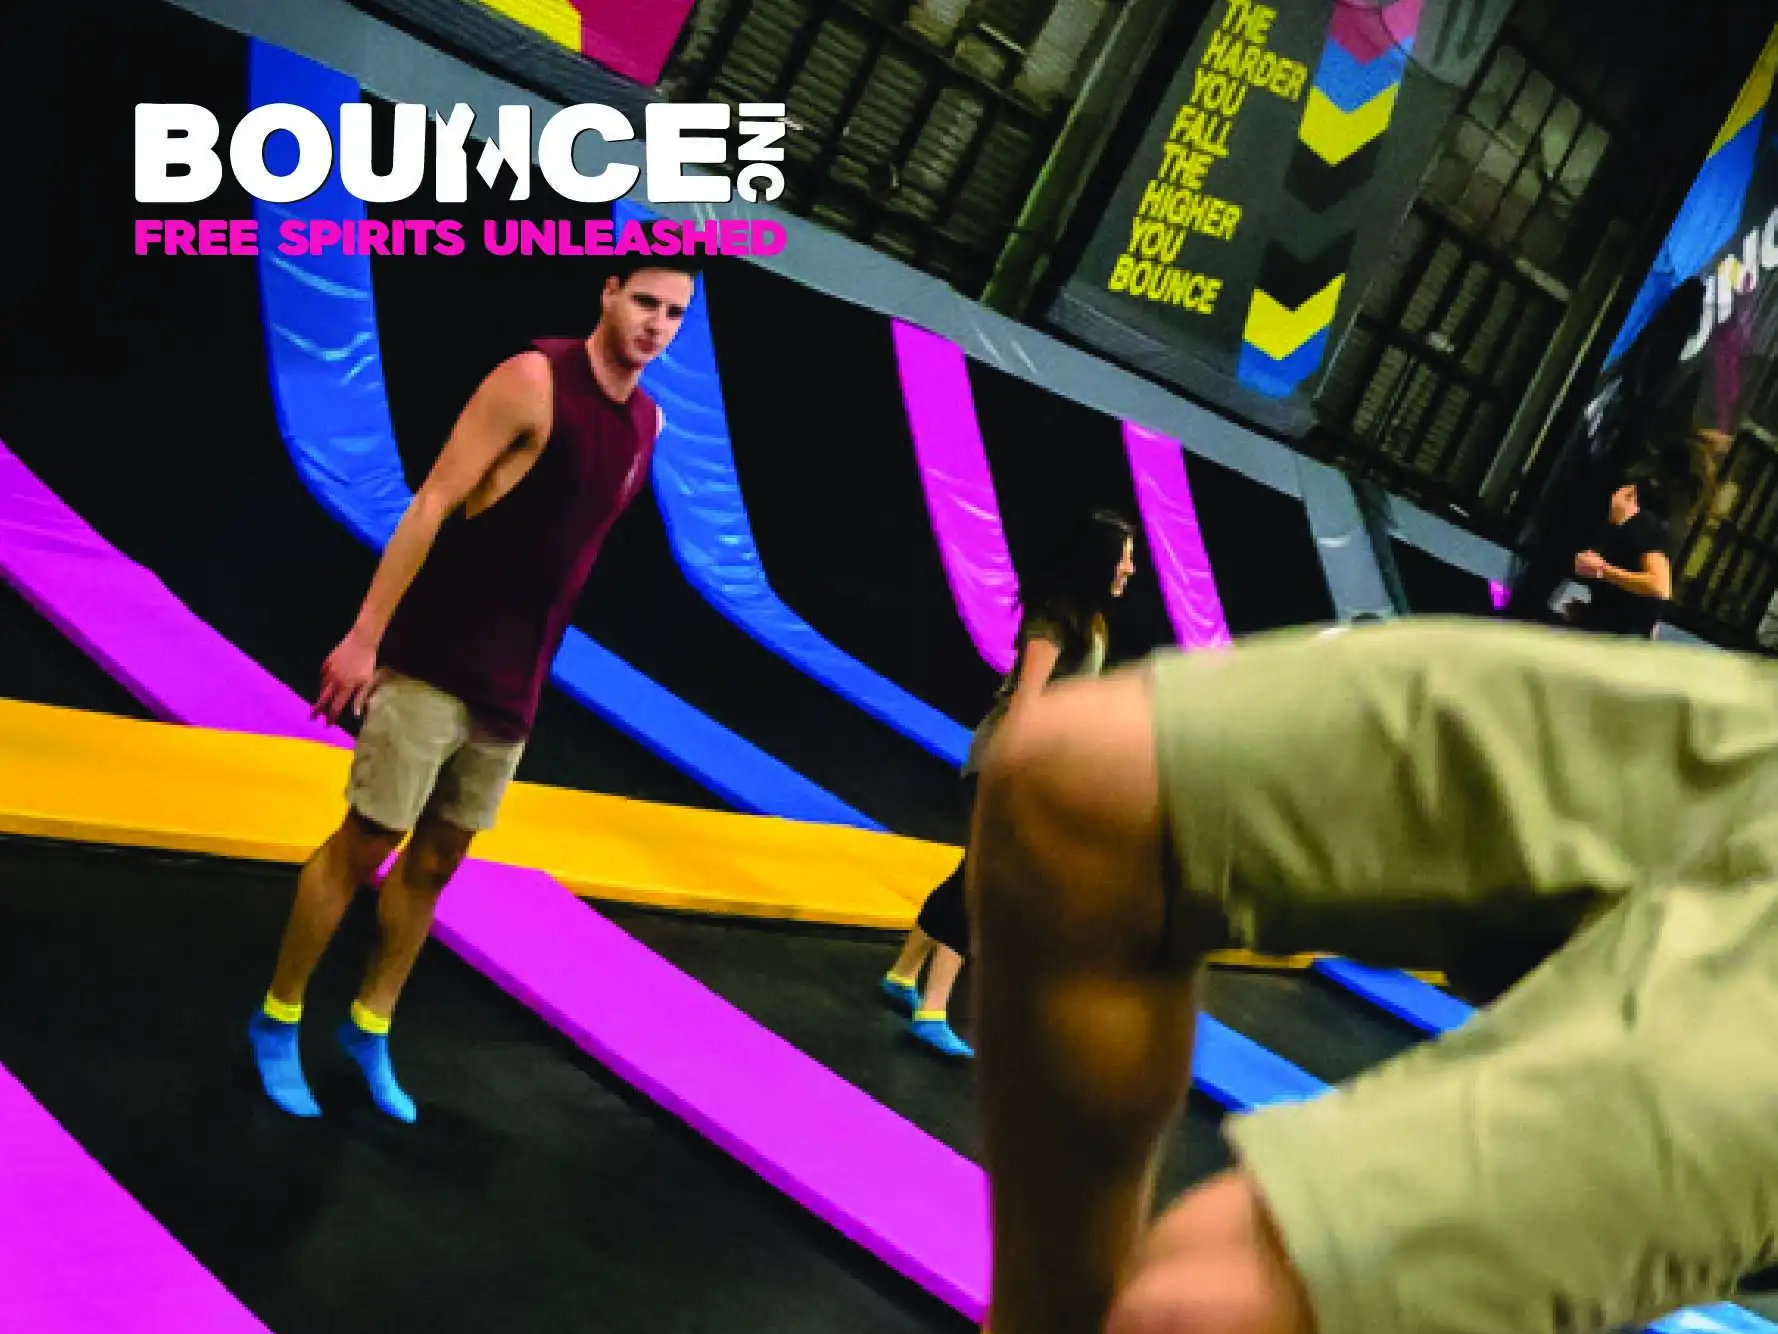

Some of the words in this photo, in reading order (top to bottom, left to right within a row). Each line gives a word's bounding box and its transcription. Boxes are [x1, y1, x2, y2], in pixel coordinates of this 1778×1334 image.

[1191, 66, 1249, 118] YOU
[1201, 29, 1308, 103] HARDER
[1167, 104, 1232, 158] FALL
[1157, 141, 1214, 190] THE
[1138, 179, 1244, 242] HIGHER
[1127, 216, 1188, 262] YOU
[1108, 253, 1224, 315] BOUNCE
